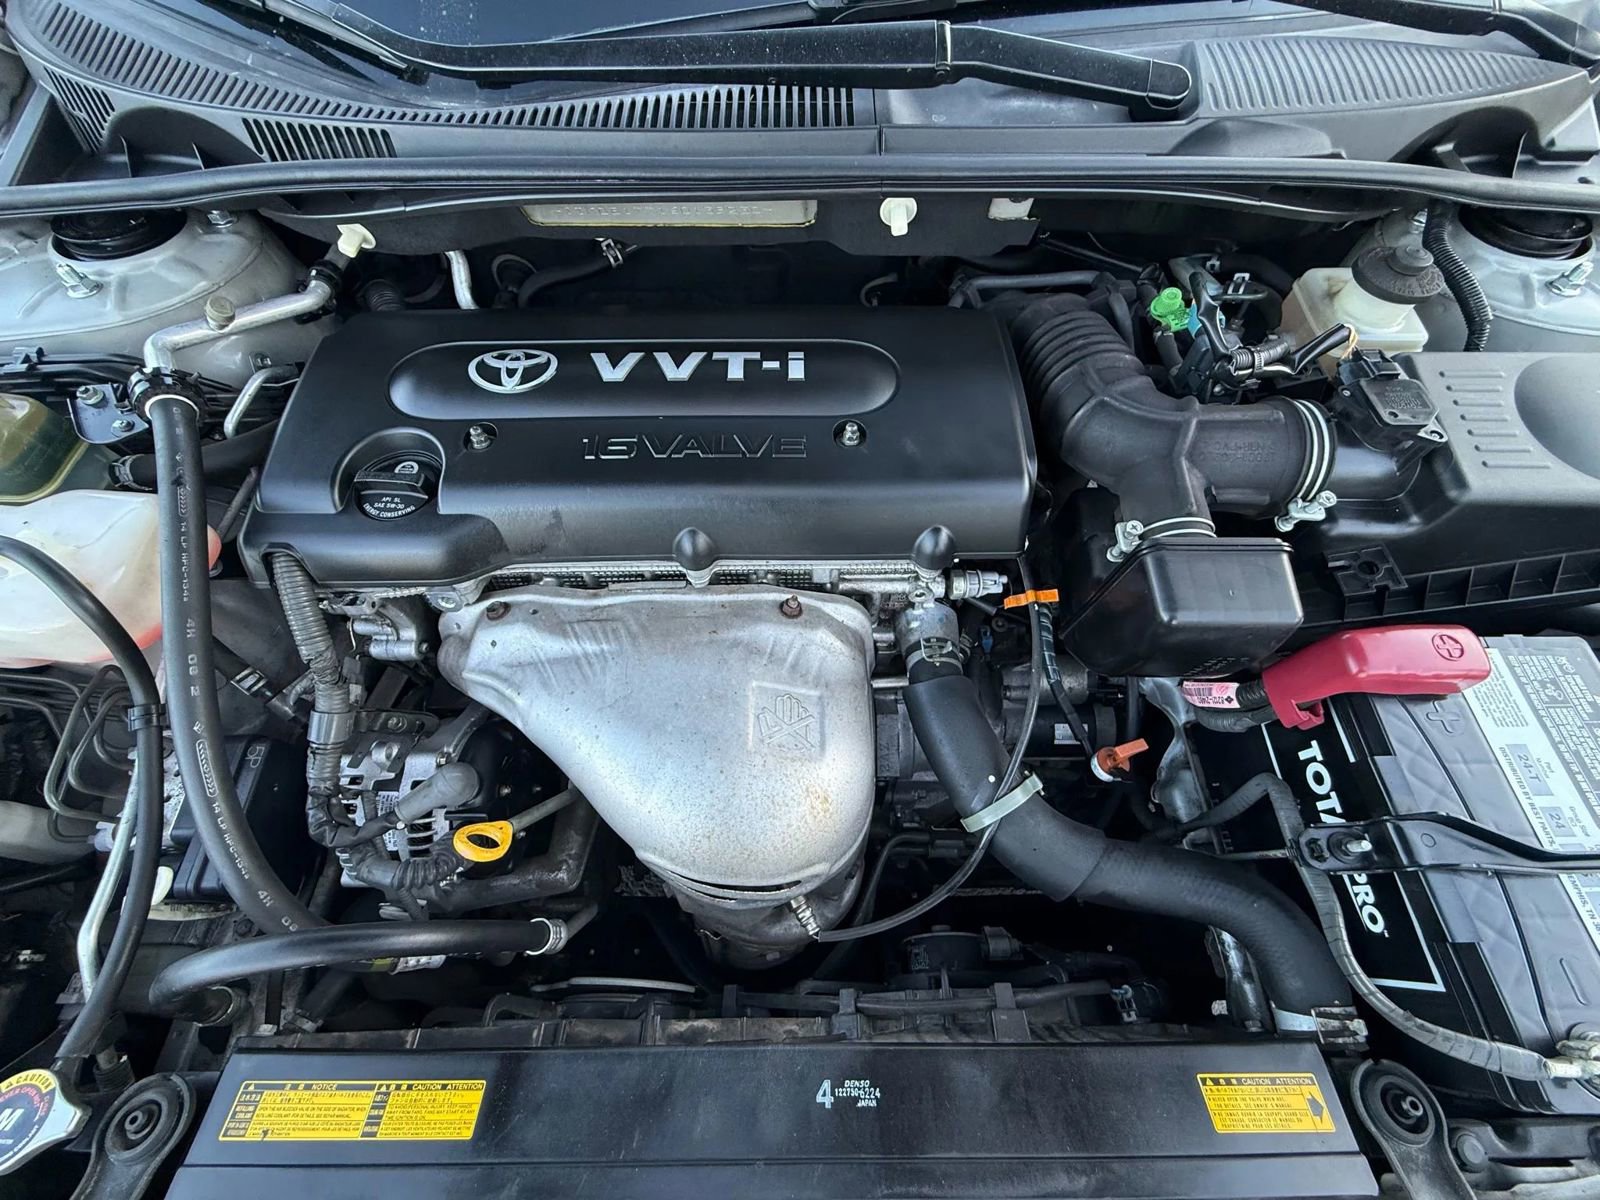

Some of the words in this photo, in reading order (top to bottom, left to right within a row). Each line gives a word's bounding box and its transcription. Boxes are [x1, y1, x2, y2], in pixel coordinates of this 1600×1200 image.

[590, 351, 805, 382] VVT-i
[1515, 754, 1542, 781] 24-T
[1547, 813, 1567, 828] 24
[15, 1073, 52, 1091] CAUTION
[312, 1083, 337, 1091] NOTICE
[412, 1083, 442, 1091] CAUTION
[446, 1083, 484, 1091] ATTENTION
[844, 1080, 870, 1088] DENSO
[816, 1079, 834, 1109] 4
[856, 1099, 877, 1107] JAPAN
